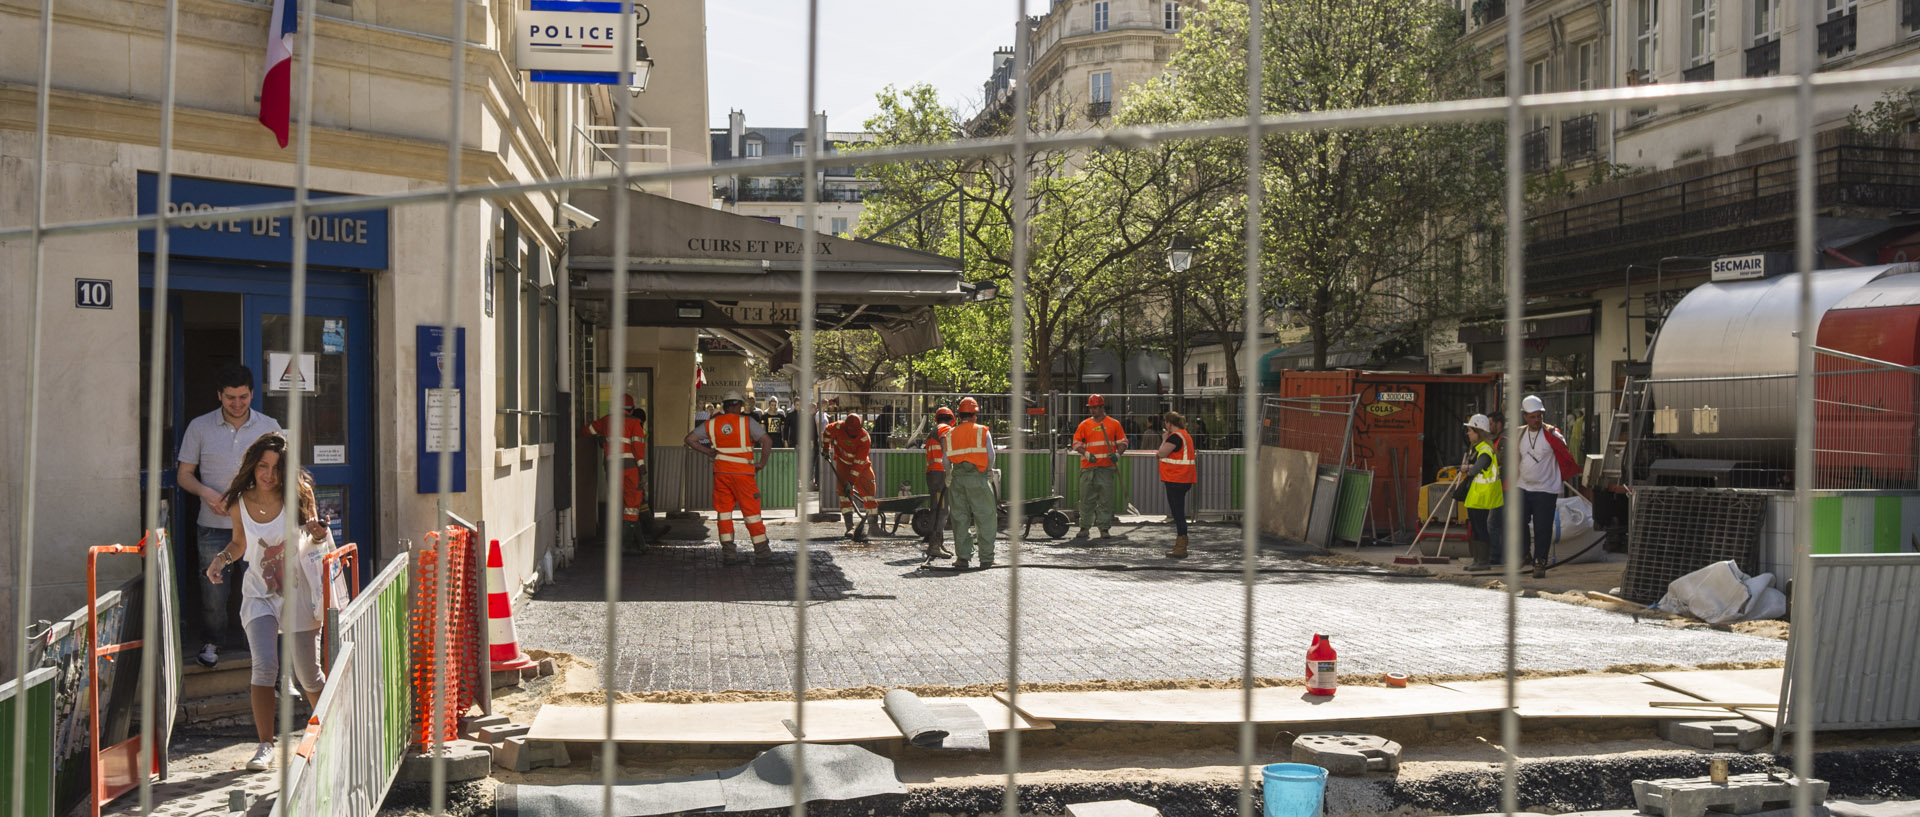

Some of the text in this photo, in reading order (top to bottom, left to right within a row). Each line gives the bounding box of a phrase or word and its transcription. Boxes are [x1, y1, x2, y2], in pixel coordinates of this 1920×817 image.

[530, 25, 613, 40] POLICE
[252, 211, 281, 238] DE
[292, 214, 367, 244] OLICE
[688, 238, 741, 253] CUIRS
[747, 240, 769, 254] ET
[1714, 258, 1761, 272] SECMAIR
[80, 282, 107, 305] 10
[1370, 405, 1395, 413] COLAS
